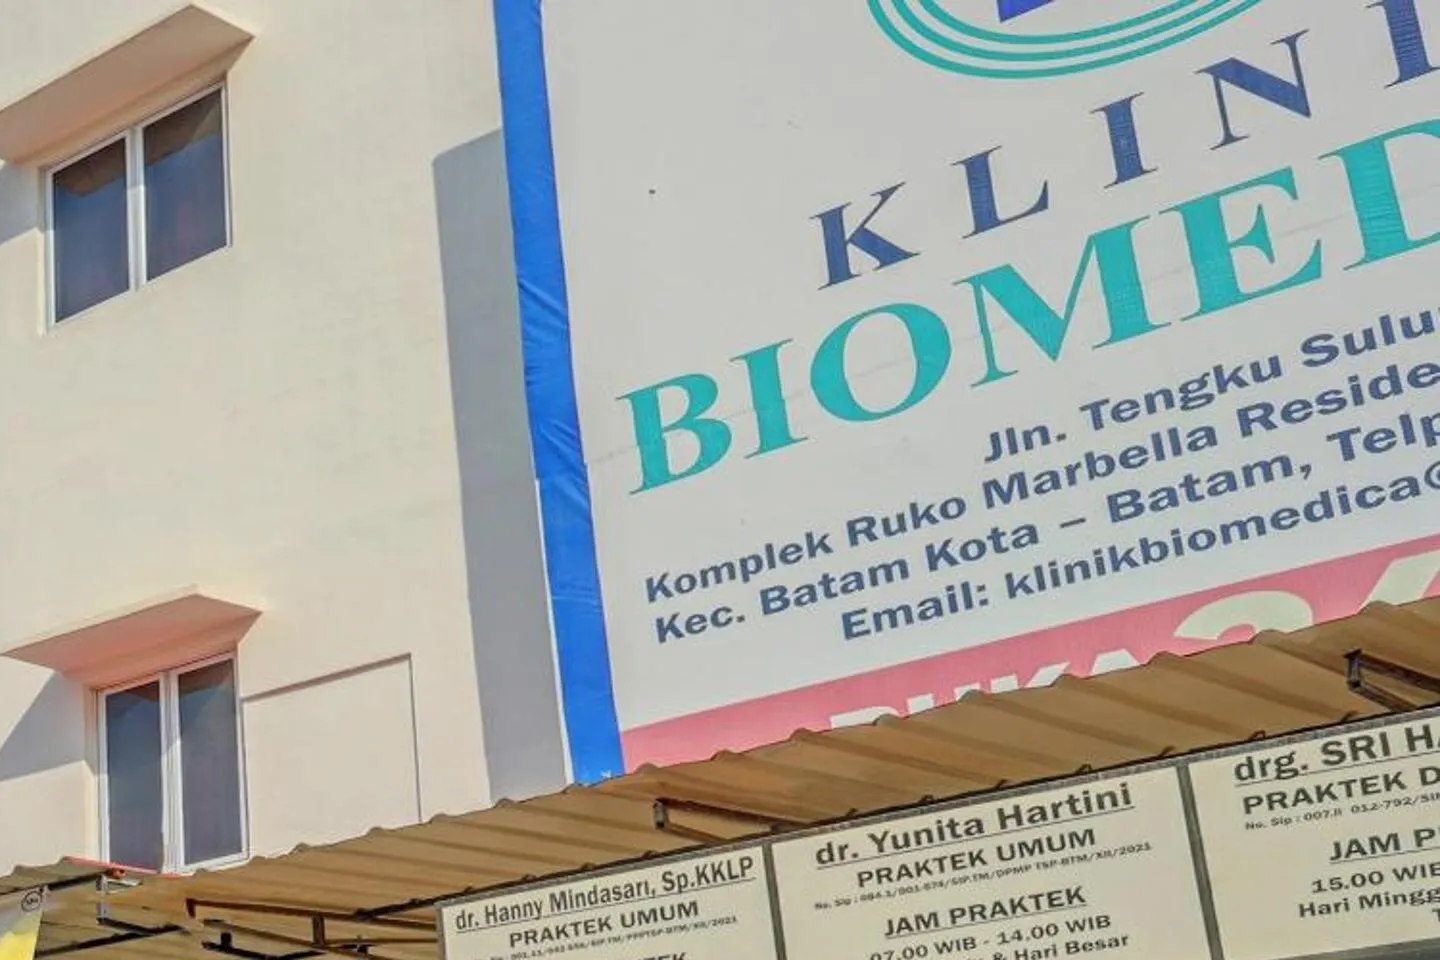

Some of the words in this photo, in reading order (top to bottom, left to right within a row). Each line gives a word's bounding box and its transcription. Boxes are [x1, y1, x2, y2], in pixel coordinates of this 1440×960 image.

[983, 418, 1067, 463] Jln.
[1080, 354, 1283, 434] Tengku
[1300, 307, 1440, 368] Sulu
[644, 524, 834, 604] Komplek
[845, 490, 967, 548] Ruko
[980, 418, 1219, 506] Marbella
[1238, 362, 1440, 442] Reside
[654, 600, 746, 645] Kec.
[759, 550, 911, 616] Batam
[925, 520, 1041, 572] Kota
[1106, 448, 1314, 525] Batam,
[840, 580, 990, 641] Email:
[1234, 750, 1308, 781] drg.
[1321, 731, 1391, 767] SRI
[1405, 723, 1440, 752] H
[1243, 771, 1407, 815] PRAKTEK
[816, 841, 859, 865] dr.
[867, 812, 987, 855] Yunita
[995, 782, 1133, 829] Hartini
[1330, 832, 1401, 862] JAM
[857, 846, 988, 889] PRAKTEK
[997, 828, 1096, 863] UMUM
[1312, 870, 1384, 894] 15.00
[455, 907, 480, 930] dr.
[485, 898, 542, 925] Hanny
[662, 856, 754, 894] Sp.KKLP
[884, 909, 941, 938] JAM
[949, 885, 1087, 927] PRAKTEK
[1298, 897, 1350, 918] Hari
[509, 915, 612, 948] PRAKTEK
[620, 900, 699, 929] UMUM
[933, 935, 977, 957] WIB
[996, 922, 1060, 947] 14.00
[1065, 913, 1111, 937] WIB
[1065, 931, 1130, 955] Besar
